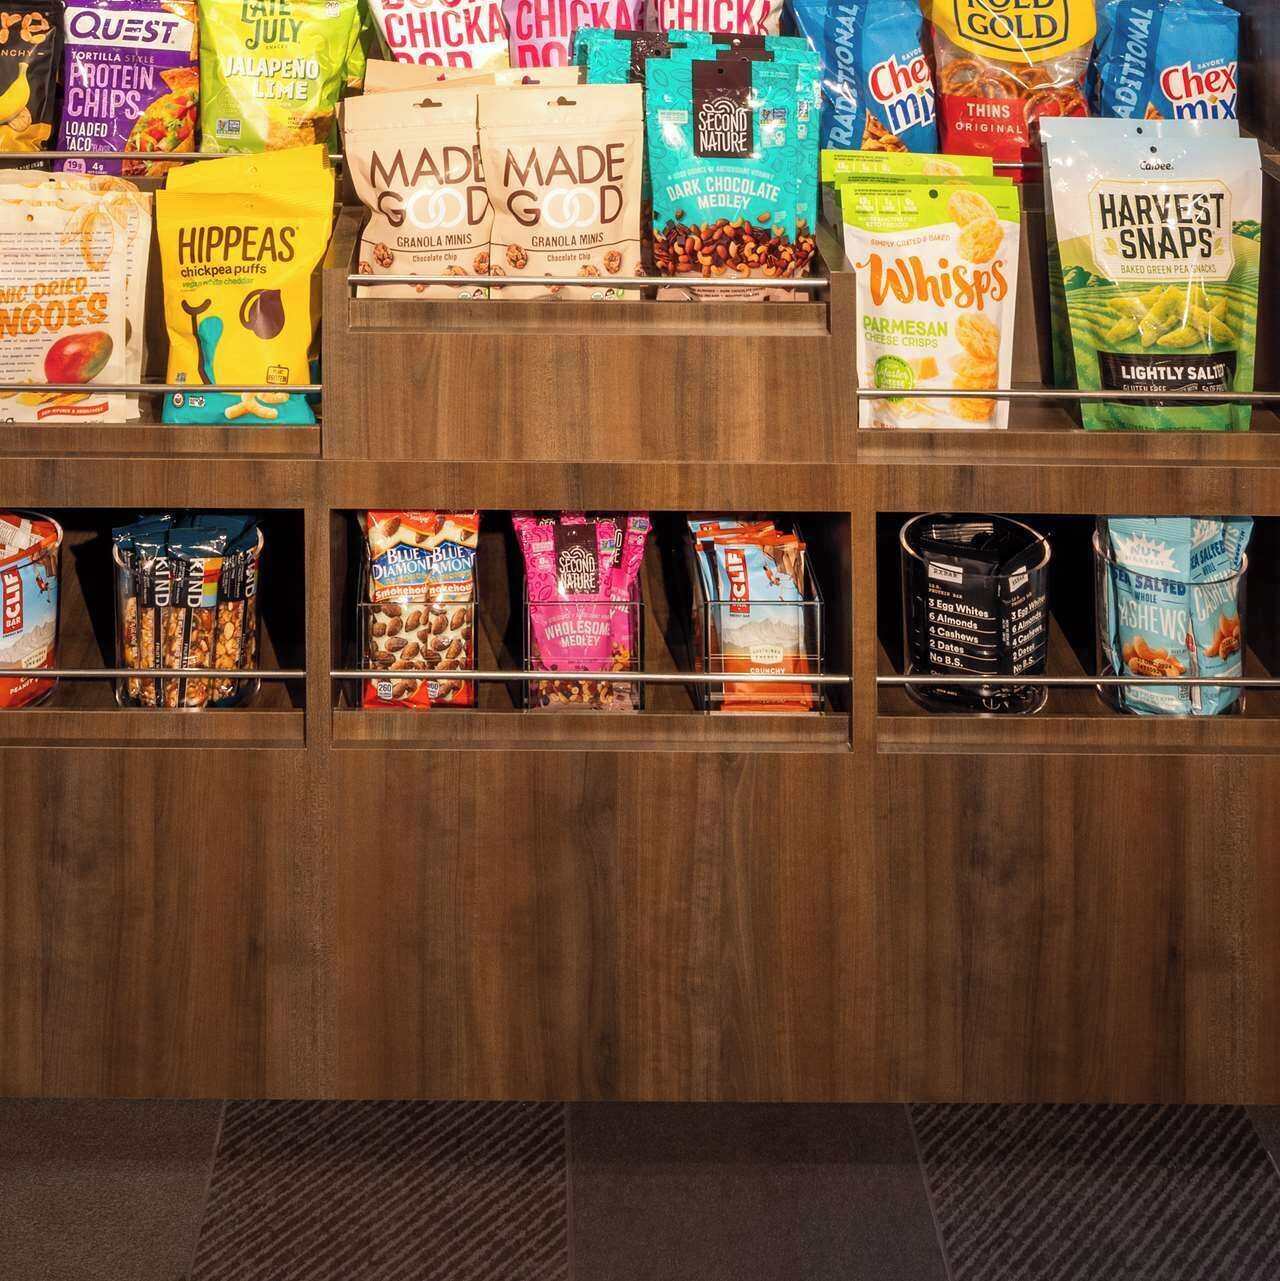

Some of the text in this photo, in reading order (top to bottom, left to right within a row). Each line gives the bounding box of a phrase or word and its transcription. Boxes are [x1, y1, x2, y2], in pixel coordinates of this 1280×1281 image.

[70, 10, 179, 44] QUEST
[245, 18, 304, 50] JULY
[384, 2, 510, 49] CHICKA
[968, 13, 1058, 40] GOLD
[71, 51, 155, 64] TORTILLA STYLE
[70, 64, 155, 90] PROTEIN
[224, 56, 320, 81] JALAPEÑO
[827, 4, 859, 150] TRADITIONAL
[254, 80, 309, 101] LIME
[1161, 64, 1237, 101] Chex
[67, 87, 141, 120] CHIPS
[966, 102, 1011, 119] THINS
[66, 121, 108, 137] LOADED
[698, 110, 748, 132] SECOND
[955, 121, 1023, 135] ORIGINAL
[65, 137, 92, 152] TACO
[699, 131, 748, 153] NATURE
[371, 144, 487, 189] MADE
[504, 142, 625, 187] MADE
[666, 176, 781, 202] DARK CHOCOLATE
[377, 184, 490, 230] GOOD
[506, 183, 624, 229] GOOD
[697, 194, 752, 210] MEDLEY
[1098, 193, 1224, 230] HARVEST
[178, 225, 296, 265] HIPPEAS
[396, 233, 473, 247] GRANOLA MINIS
[531, 232, 604, 247] GRANOLA MINIS
[1120, 226, 1214, 260] SNAPS
[412, 254, 443, 263] Chocolate
[547, 254, 578, 262] Chocolate
[181, 263, 267, 278] chickpea puffs
[1120, 264, 1190, 274] BAKED GREEN PEA
[34, 276, 88, 300] DRIED
[855, 253, 1009, 311] Whisps
[863, 315, 949, 337] PARMESAN
[865, 334, 939, 348] CHEESE CRISPS
[1121, 366, 1184, 381] LIGHTLY
[387, 547, 420, 564] BLUE
[432, 546, 465, 563] BLUE
[558, 553, 596, 573] SECOND
[154, 556, 169, 607] KIND
[187, 558, 205, 608] KIND
[245, 549, 258, 598] KIND
[559, 572, 597, 589] NATURE
[727, 553, 746, 598] CLIF
[4, 573, 21, 618] CLIF
[1135, 576, 1186, 596] SALTED
[928, 598, 989, 618] 3 Egg Whites
[1135, 592, 1157, 604] WHOLE
[928, 612, 978, 630] 6 Almonds
[560, 635, 601, 648] MEDLEY
[928, 625, 979, 644] 4 Cashews
[929, 639, 965, 654] 2 Dates
[929, 653, 964, 667] No B.S.
